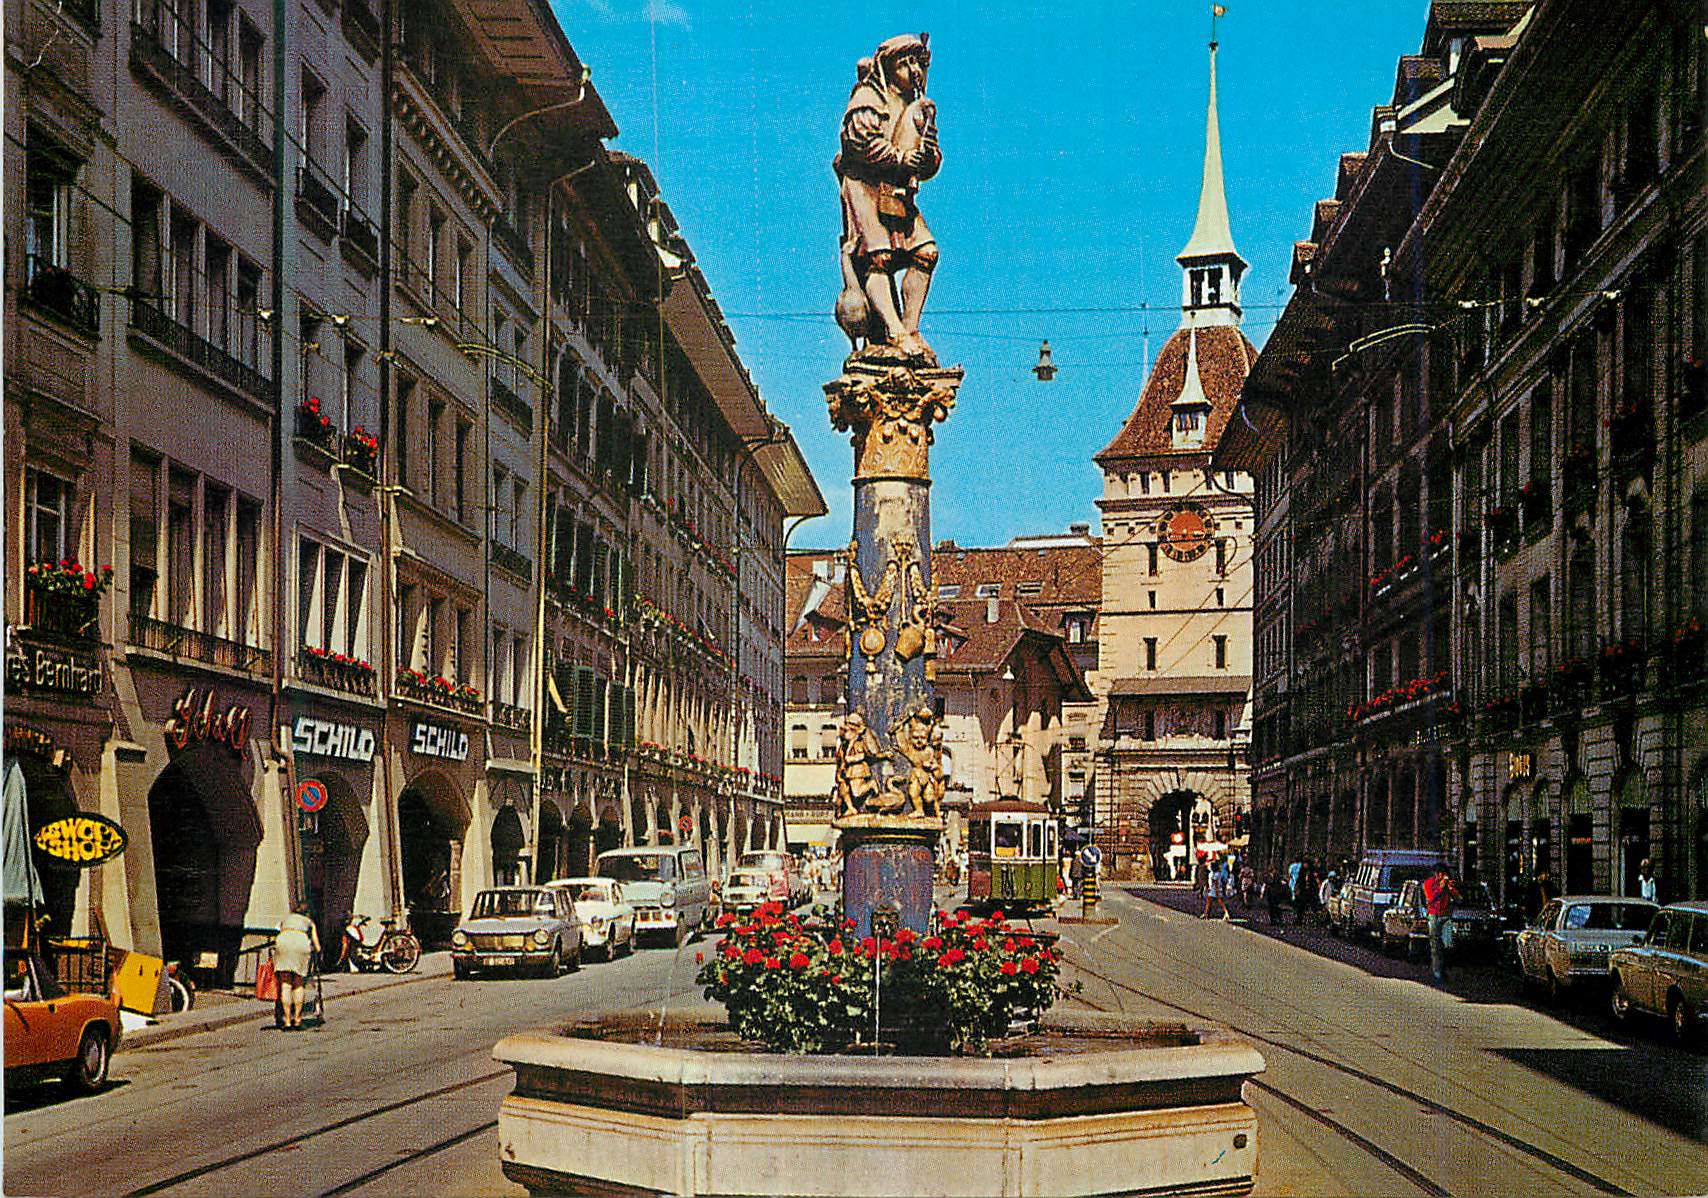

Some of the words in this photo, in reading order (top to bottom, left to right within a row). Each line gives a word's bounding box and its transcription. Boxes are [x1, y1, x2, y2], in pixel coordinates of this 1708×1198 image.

[35, 650, 103, 694] Bernhard
[293, 716, 375, 762] SCHILD
[412, 722, 469, 761] SCHILD
[46, 839, 111, 862] SHOP
